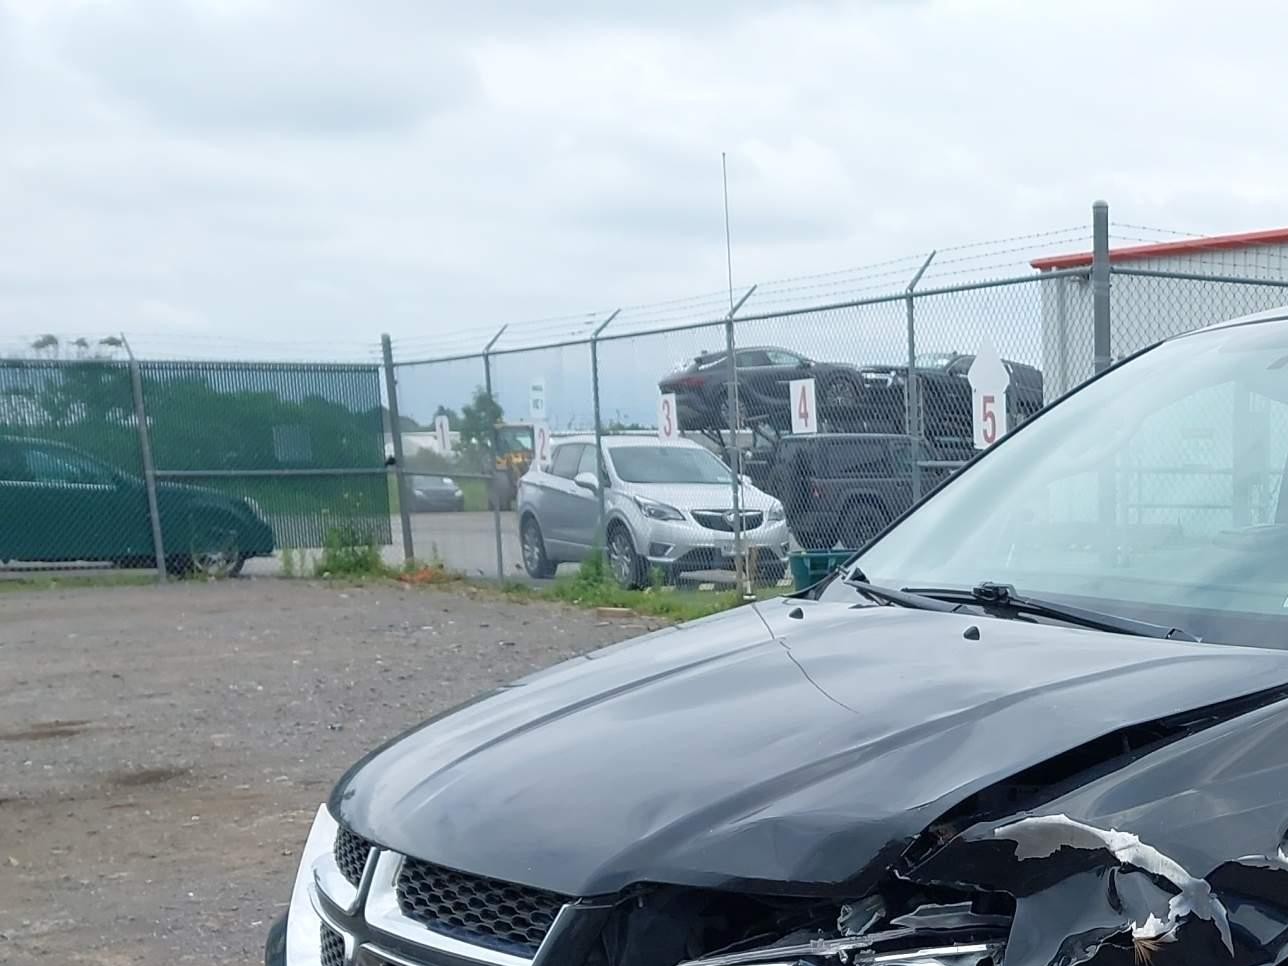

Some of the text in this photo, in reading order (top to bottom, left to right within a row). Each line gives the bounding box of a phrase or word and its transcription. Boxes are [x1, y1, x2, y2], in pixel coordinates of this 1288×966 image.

[662, 399, 672, 437] 3
[798, 385, 809, 428] 4
[982, 395, 996, 444] 5
[538, 428, 547, 461] 2
